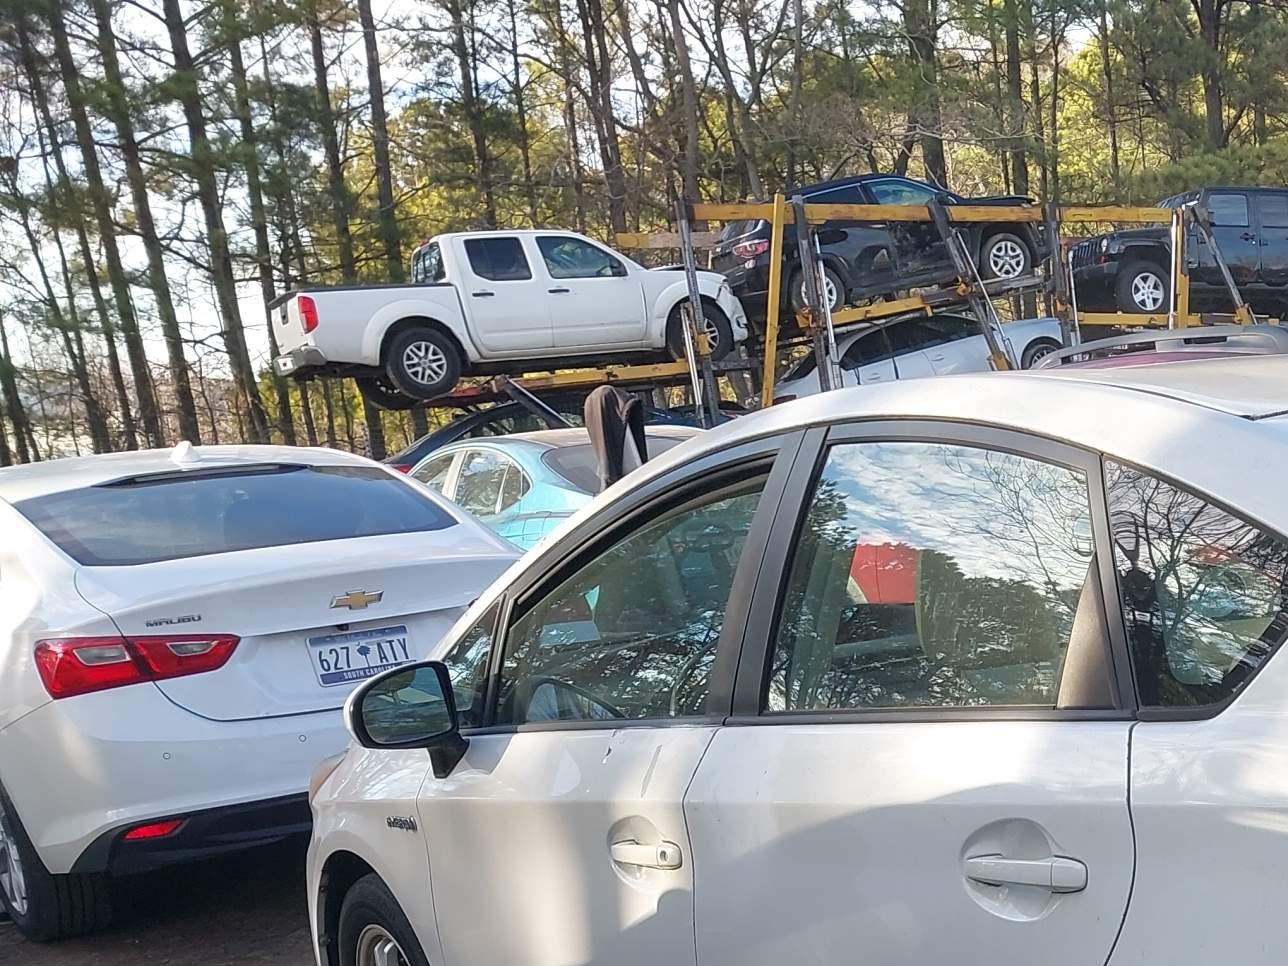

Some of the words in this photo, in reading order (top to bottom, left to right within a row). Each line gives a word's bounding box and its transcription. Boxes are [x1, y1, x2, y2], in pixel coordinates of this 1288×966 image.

[145, 613, 202, 628] MALIBU
[318, 645, 352, 673] 627
[376, 637, 410, 664] ATY
[343, 669, 365, 680] SOUTH
